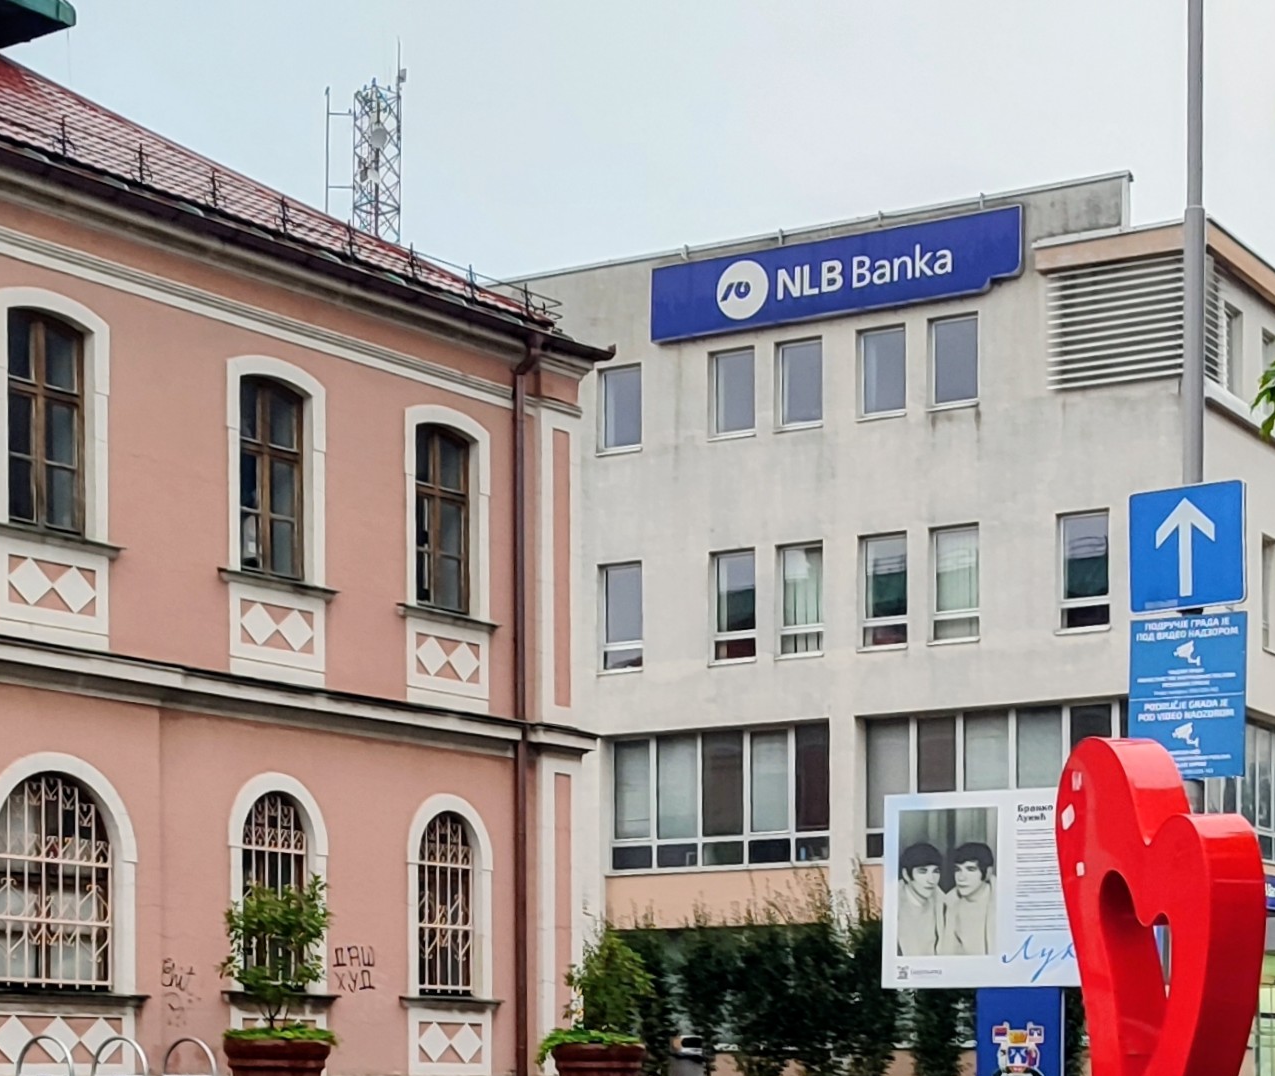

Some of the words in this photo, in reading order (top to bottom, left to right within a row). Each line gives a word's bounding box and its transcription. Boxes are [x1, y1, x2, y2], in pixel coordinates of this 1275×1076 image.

[776, 259, 843, 302] NLB
[852, 243, 953, 289] Banka
[332, 945, 376, 968] ДАШ
[333, 969, 376, 994] ХУД
